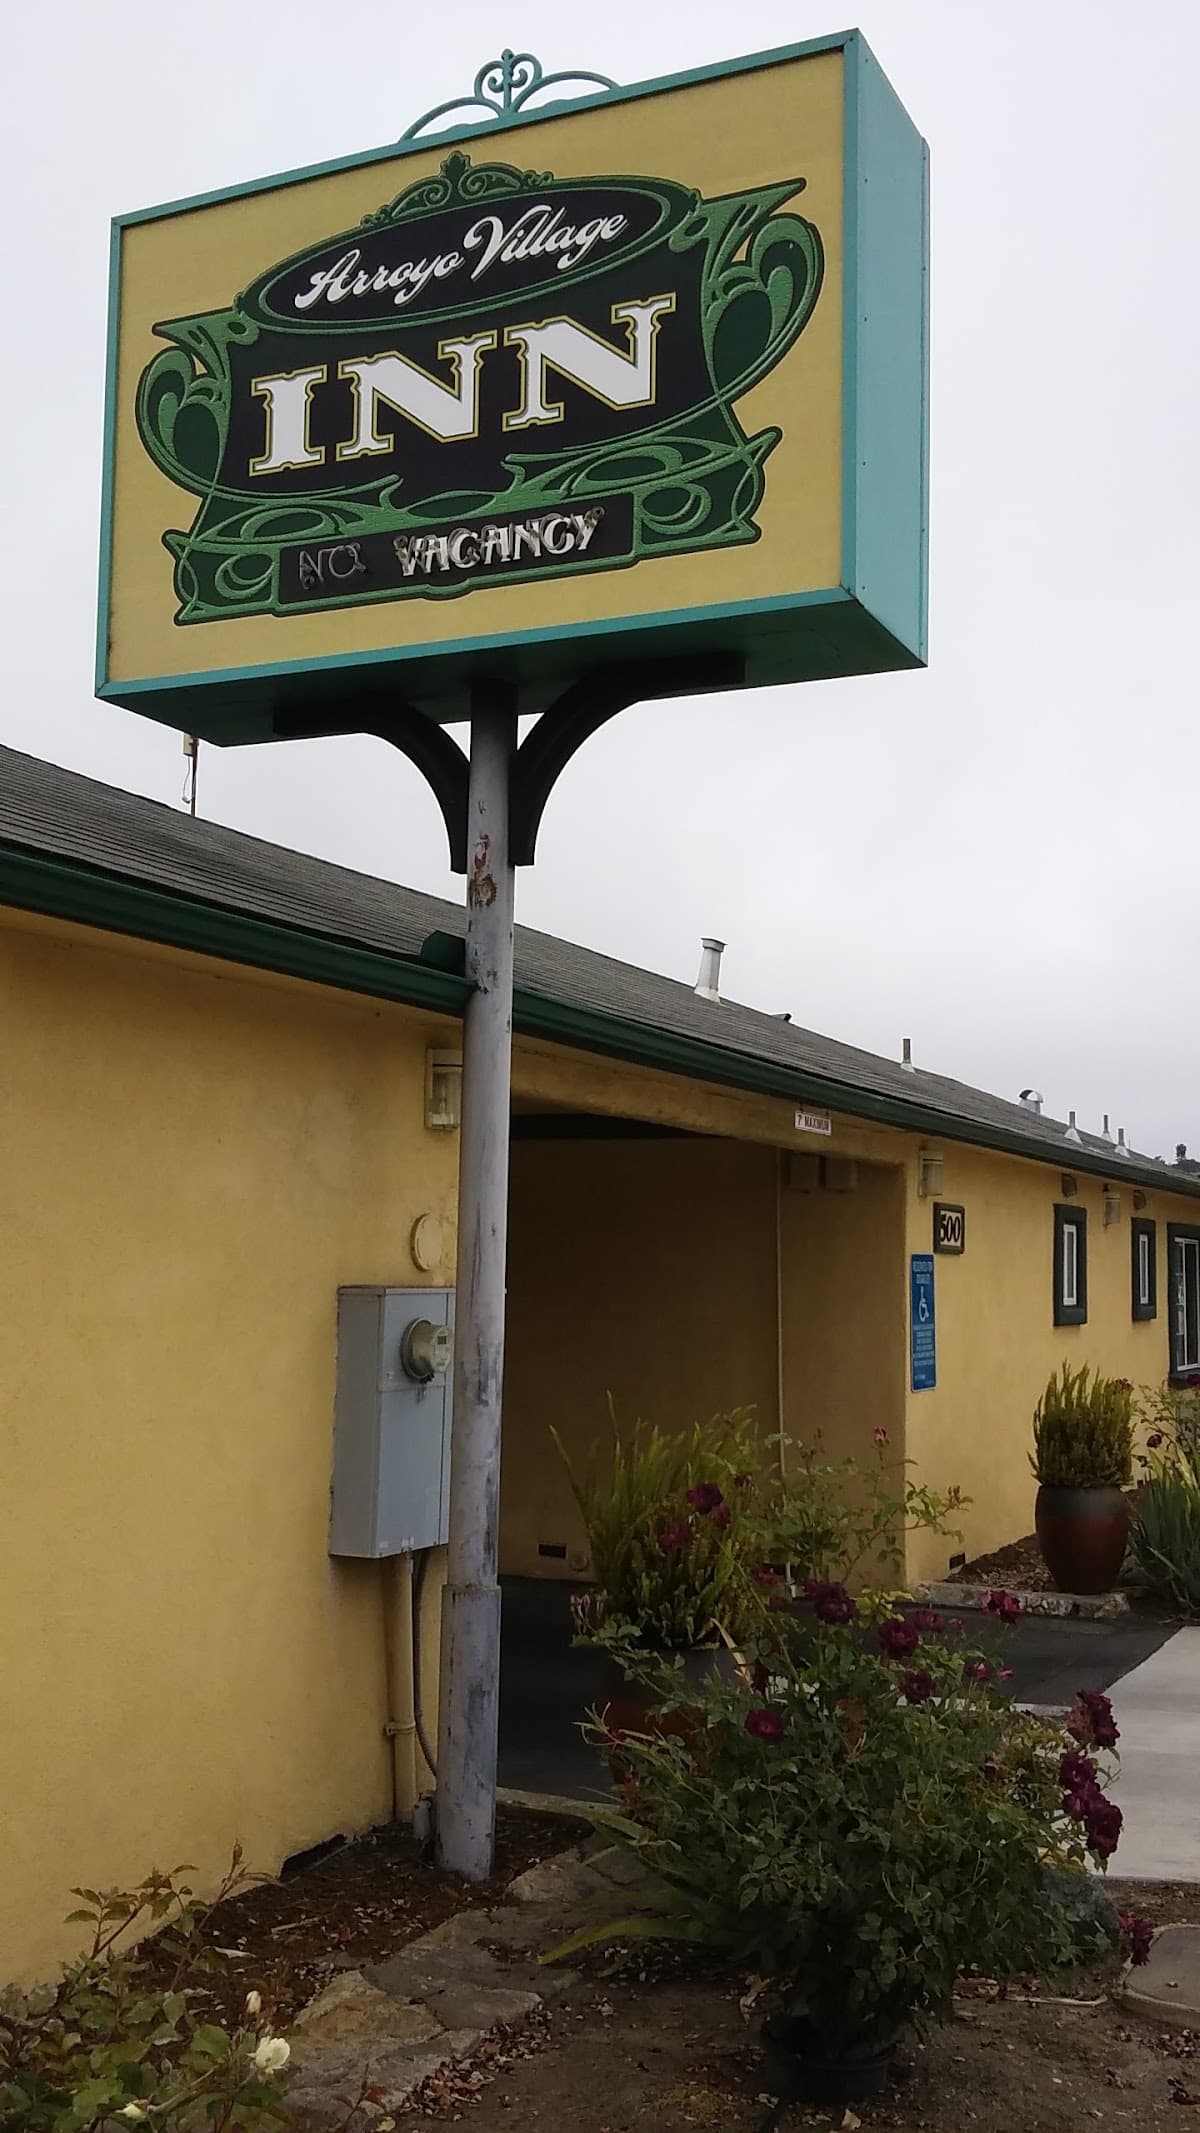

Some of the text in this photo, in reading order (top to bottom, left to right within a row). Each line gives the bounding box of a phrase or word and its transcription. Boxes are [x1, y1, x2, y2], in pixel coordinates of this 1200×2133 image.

[295, 205, 627, 308] Arroyo Village
[248, 292, 677, 477] INN
[299, 506, 605, 590] NO VACANCY
[939, 1214, 961, 1243] 500
